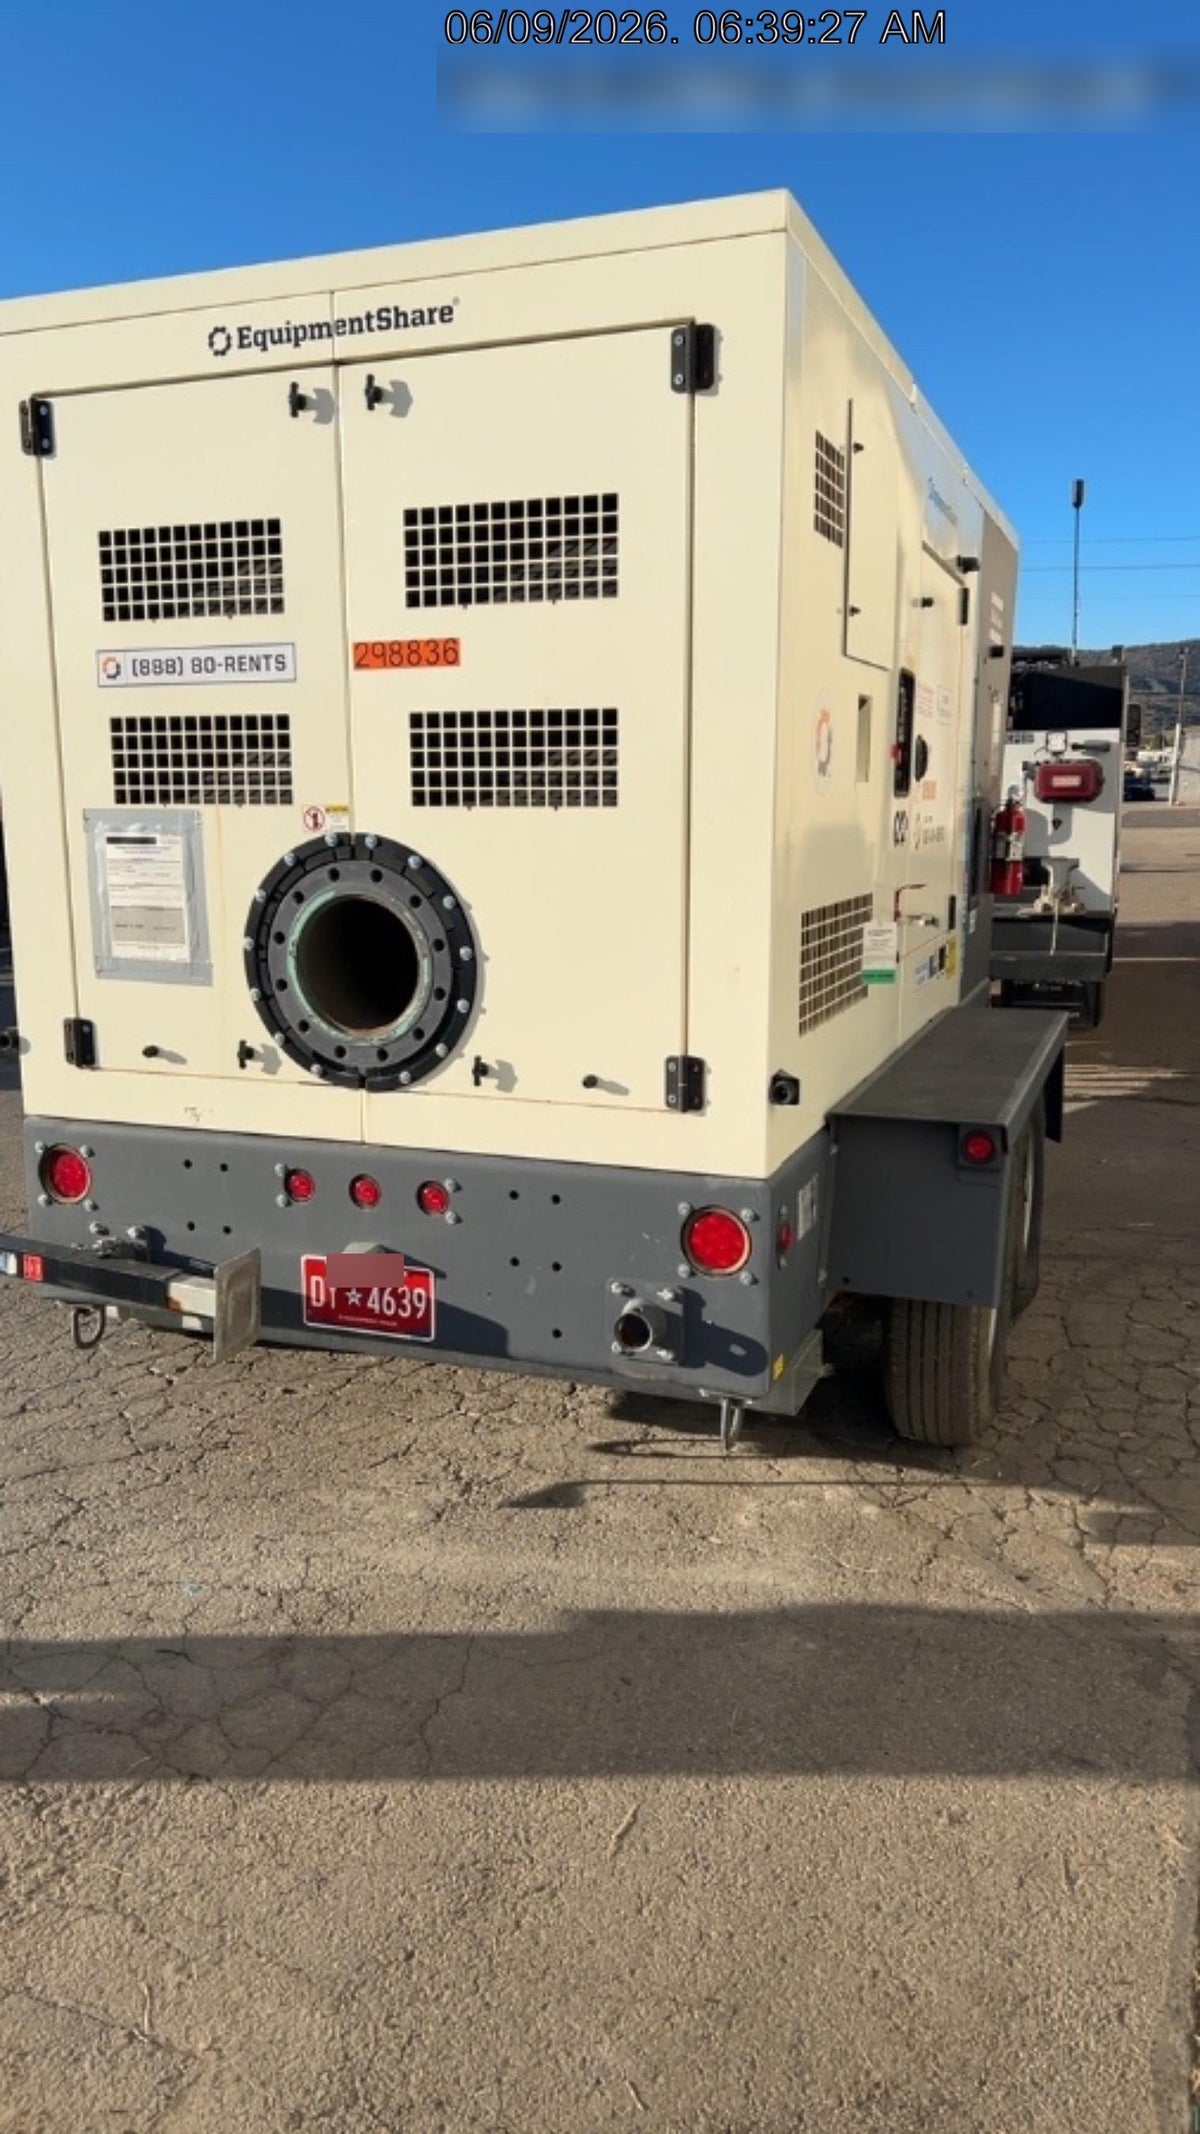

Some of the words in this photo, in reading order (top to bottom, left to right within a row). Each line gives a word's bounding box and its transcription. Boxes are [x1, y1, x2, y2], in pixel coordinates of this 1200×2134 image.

[237, 305, 454, 351] EquipmentShare
[191, 654, 287, 674] 80-RENTS
[355, 638, 459, 668] 298836
[367, 1287, 427, 1319] 4639
